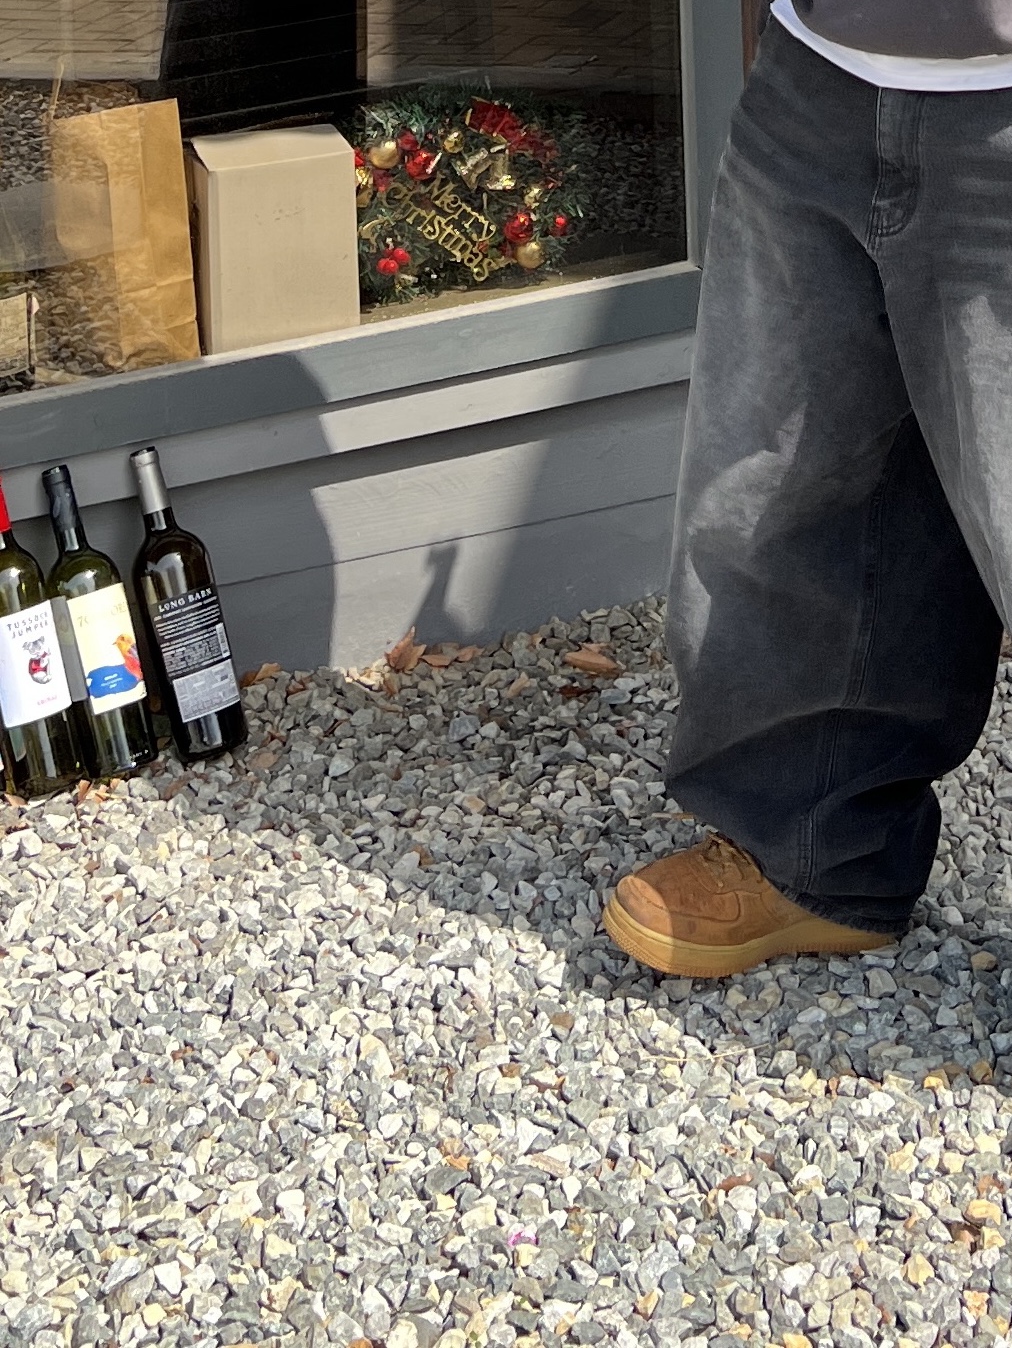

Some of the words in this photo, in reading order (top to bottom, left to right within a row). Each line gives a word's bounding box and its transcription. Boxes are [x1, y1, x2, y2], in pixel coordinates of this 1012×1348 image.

[383, 182, 495, 282] Christmas
[426, 170, 497, 241] Merry
[158, 596, 186, 613] LONG
